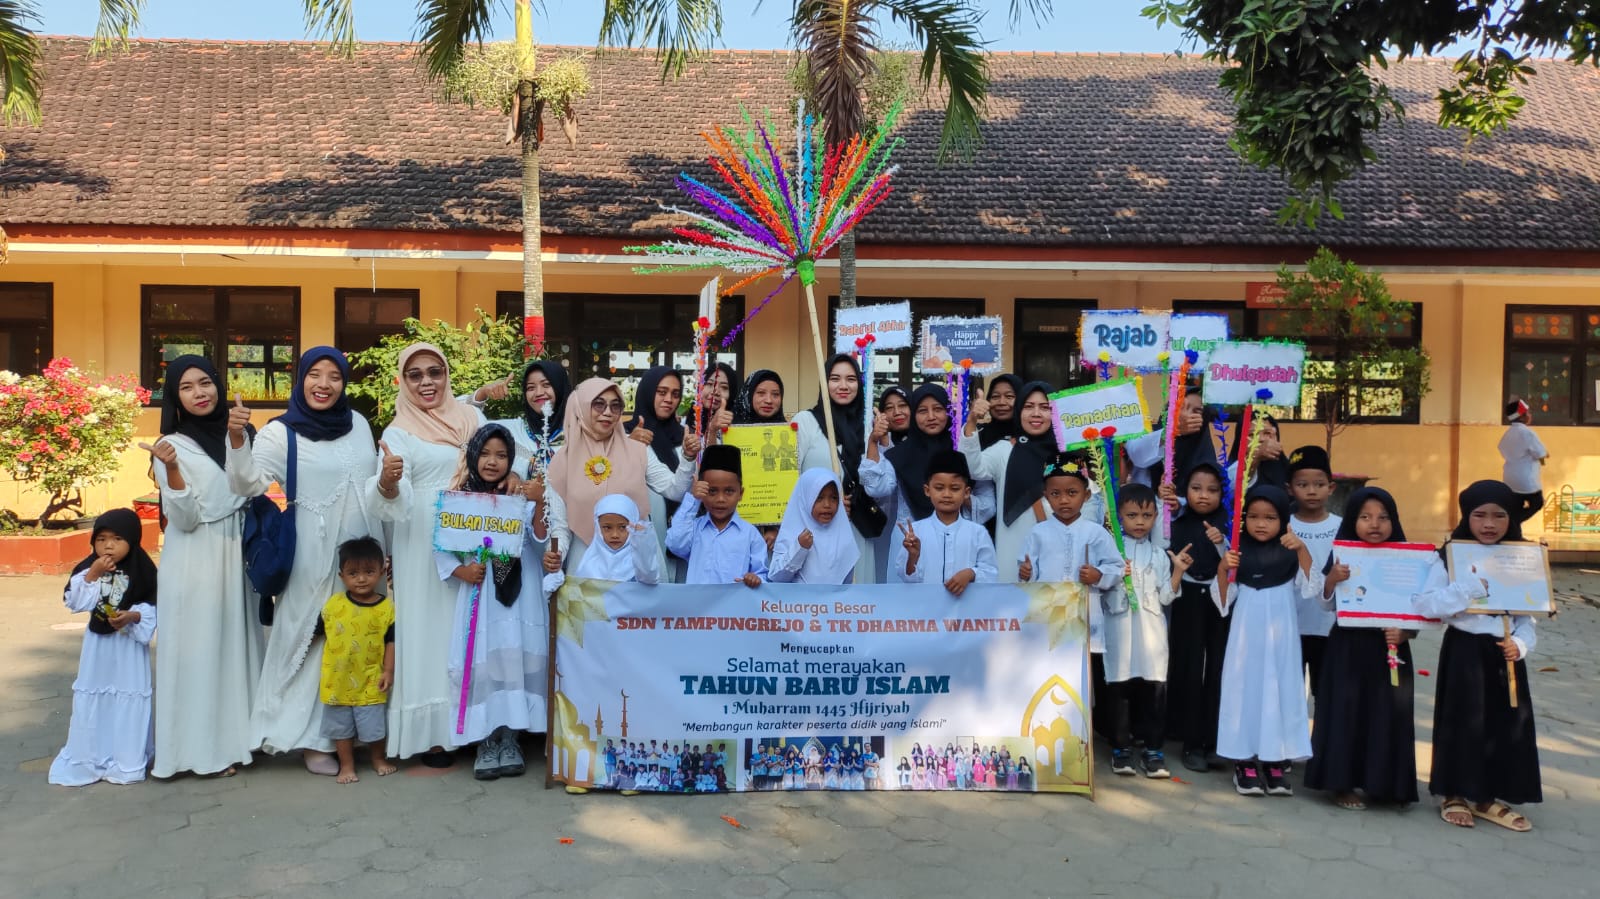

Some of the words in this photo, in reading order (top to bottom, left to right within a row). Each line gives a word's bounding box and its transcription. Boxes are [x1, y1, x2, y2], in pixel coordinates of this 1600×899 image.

[946, 338, 986, 347] Muharram
[954, 330, 979, 341] Happy
[1093, 324, 1158, 352] Rajab
[1210, 362, 1298, 386] Dhulqaidah
[1061, 403, 1141, 429] Ramadhan
[439, 512, 482, 531] BULAN
[484, 516, 522, 535] ISLAM
[761, 599, 829, 617] Keluarga
[834, 601, 877, 615] Besar
[617, 616, 657, 630] SDN
[661, 616, 805, 633] TAMPUNGREJO
[809, 619, 822, 633] &
[827, 619, 853, 633] TK
[856, 619, 939, 633] DHARMA
[943, 617, 1021, 632] WANITA
[780, 642, 855, 655] Mengucapkan
[727, 657, 799, 674] Selamat
[805, 658, 906, 677] merayakan
[679, 675, 778, 696] TAHUN
[784, 676, 860, 696] BARU
[865, 675, 951, 696] ISLAM
[723, 704, 728, 715] 1
[732, 699, 811, 715] Muharram
[816, 704, 847, 718] 1445
[849, 698, 910, 717] Hijriyah
[682, 722, 753, 734] "Membangun
[756, 719, 804, 731] karakter
[806, 720, 847, 732] peserta
[850, 719, 878, 730] didik
[880, 720, 907, 731] yang
[910, 718, 947, 730] islami"
